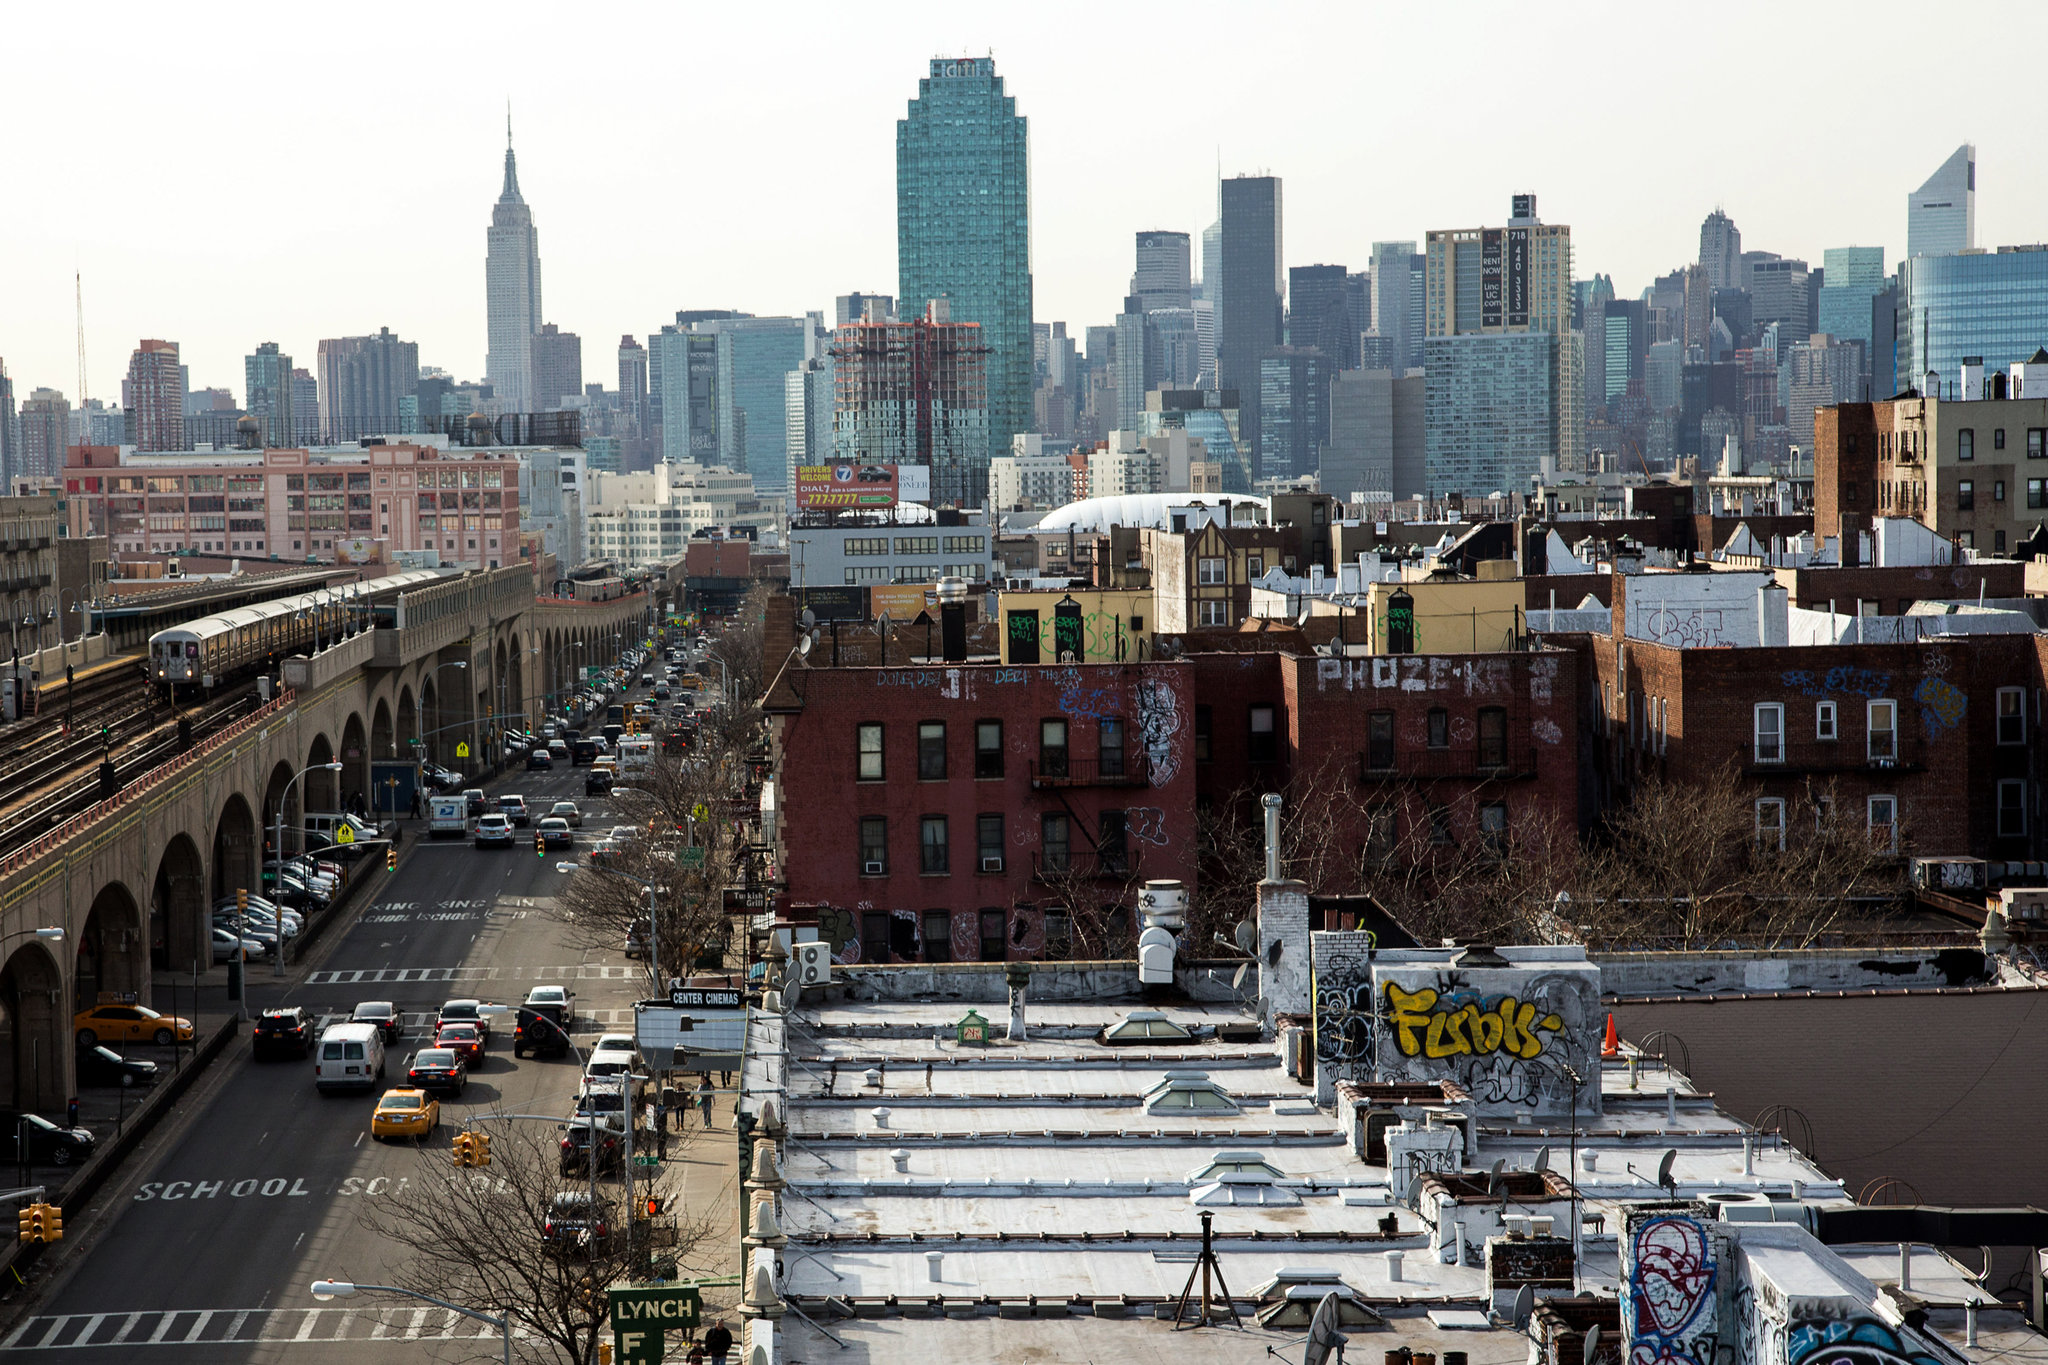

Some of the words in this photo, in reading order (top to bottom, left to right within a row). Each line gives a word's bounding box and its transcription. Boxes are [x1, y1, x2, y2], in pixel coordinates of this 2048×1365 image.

[946, 60, 975, 77] citi
[1511, 231, 1526, 240] 718
[1483, 257, 1501, 265] RENT
[1482, 267, 1501, 275] NOW
[1486, 291, 1498, 299] LIC
[691, 441, 716, 449] COAST
[800, 473, 832, 481] WELCOME
[837, 467, 848, 481] 7
[673, 992, 703, 1005] CENTER
[705, 992, 739, 1005] CINEMAS
[134, 1177, 310, 1201] SCHOOL
[617, 1299, 692, 1320] LYNCH
